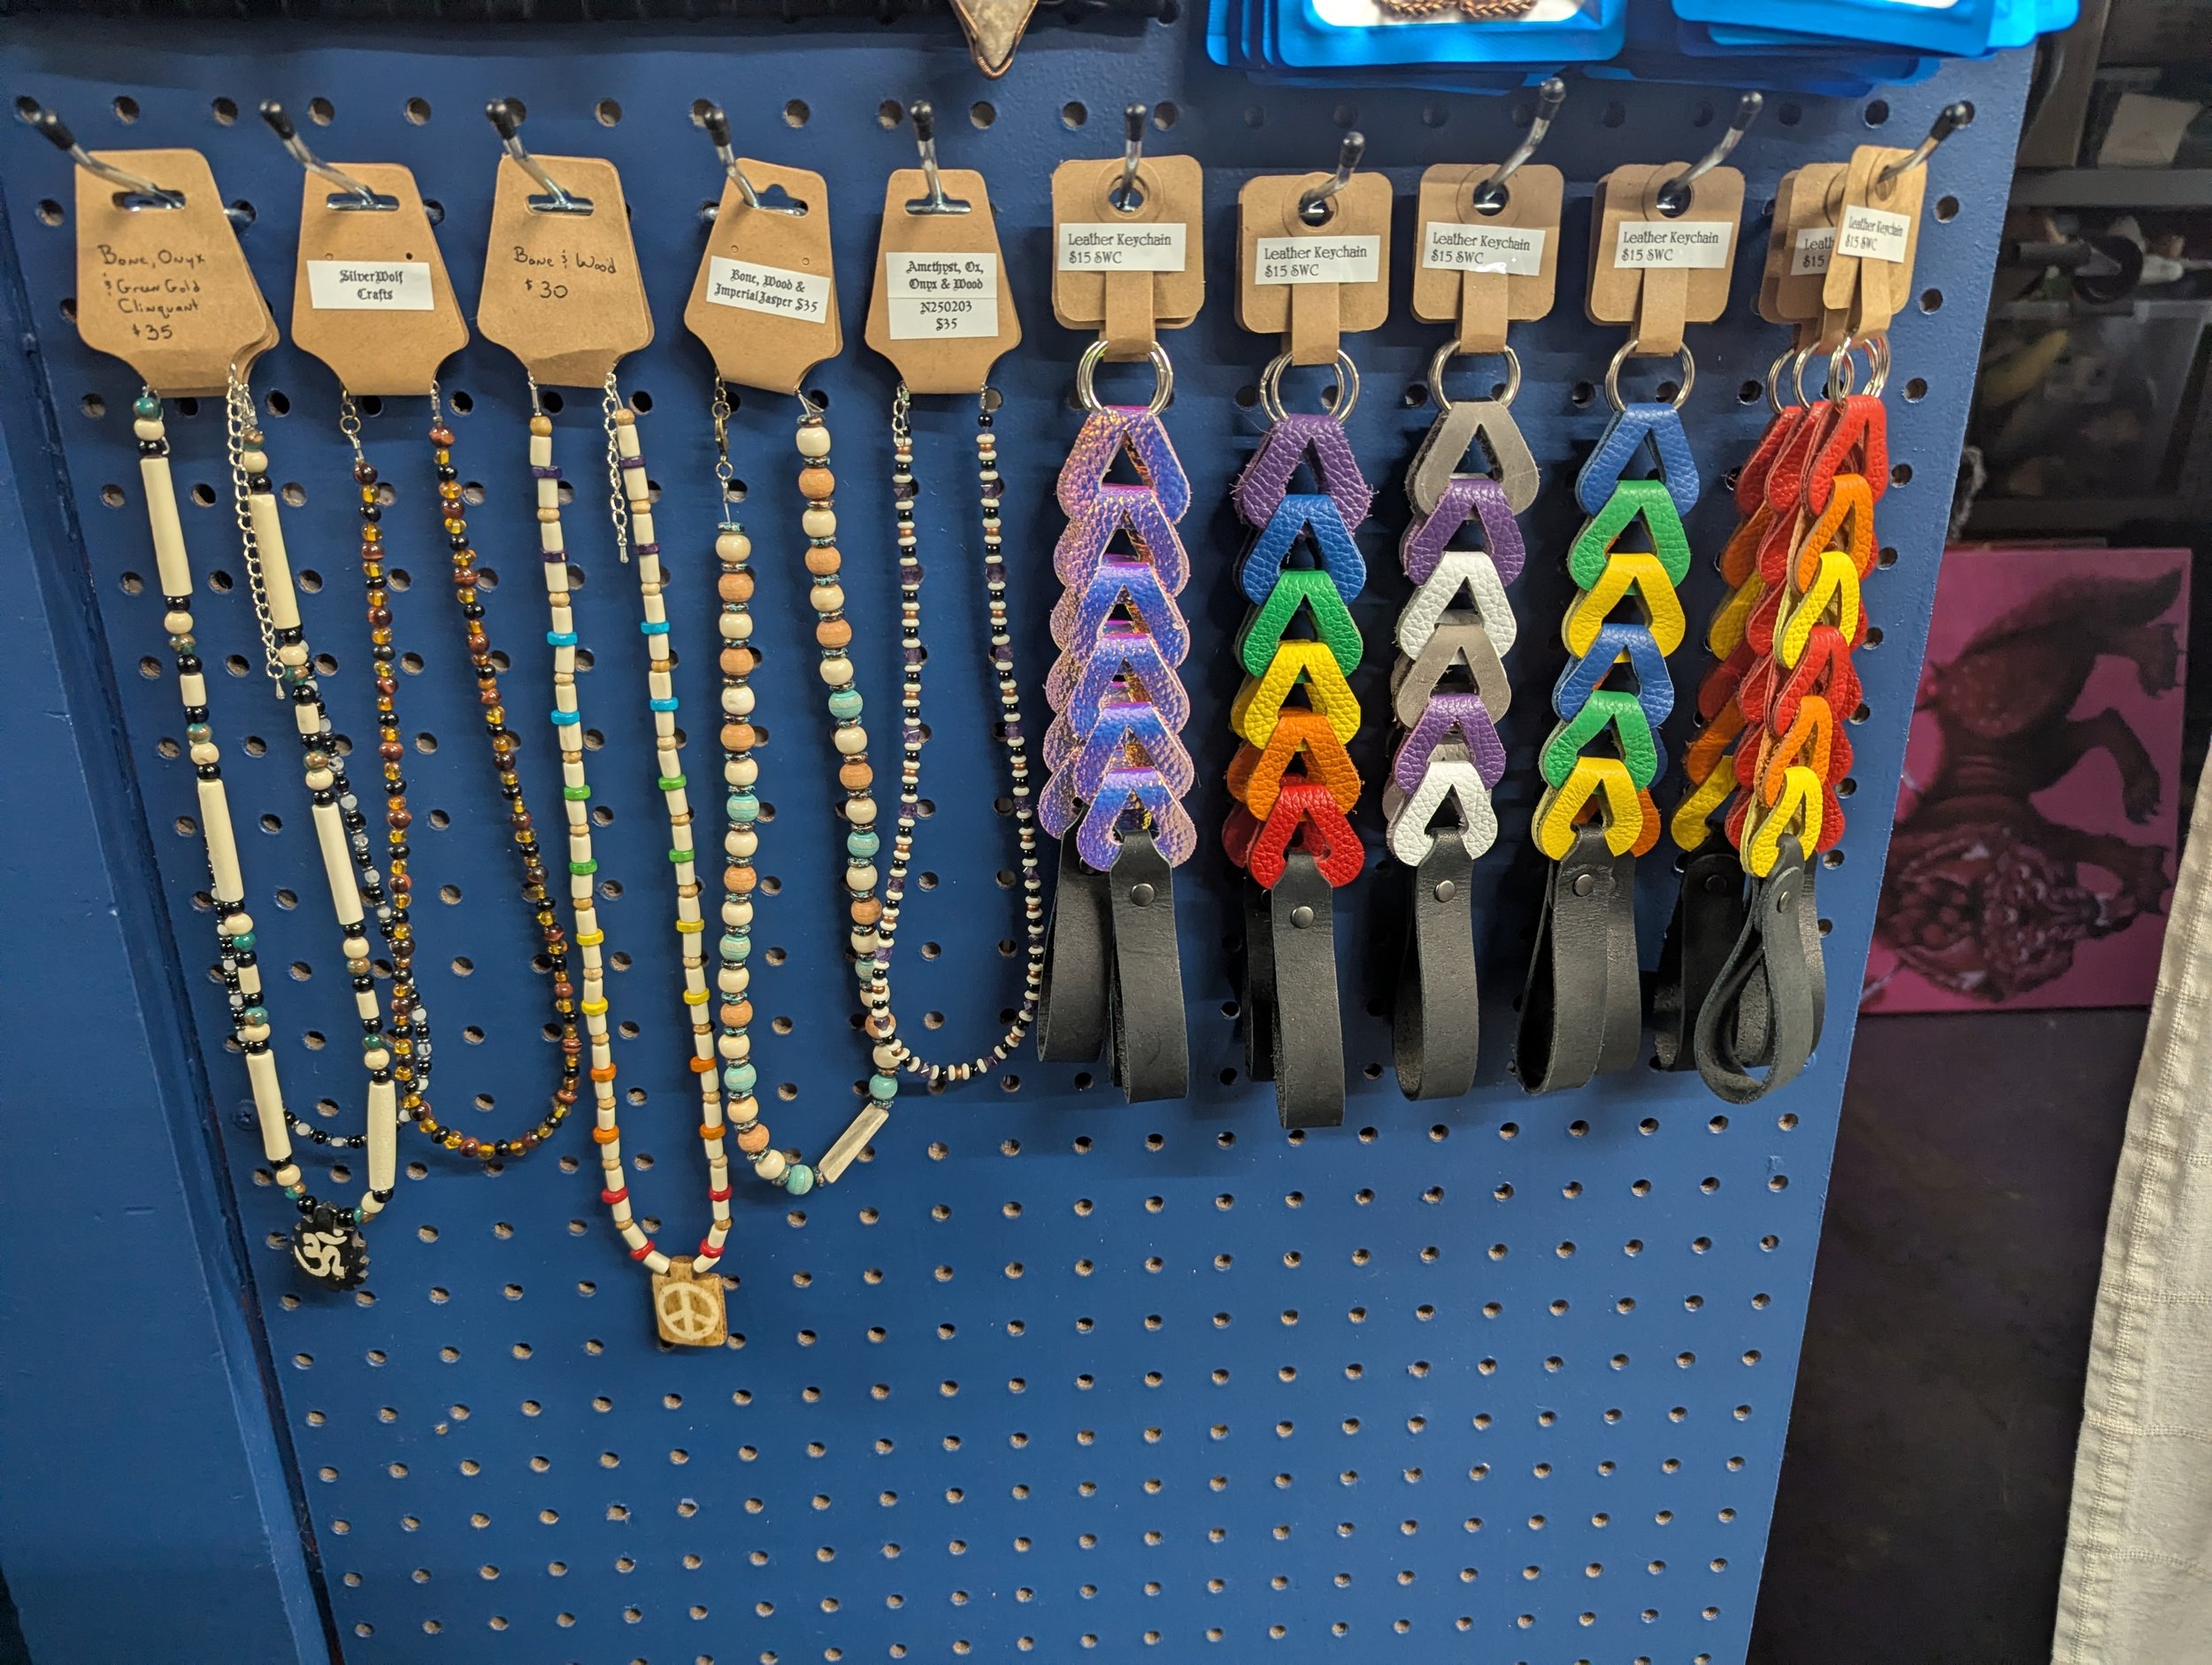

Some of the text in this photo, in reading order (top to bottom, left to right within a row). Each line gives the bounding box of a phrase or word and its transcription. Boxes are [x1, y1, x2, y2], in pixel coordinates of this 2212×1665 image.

[1848, 216, 1903, 237] Leather Keychain
[1068, 233, 1171, 248] Leather Keychain
[1432, 232, 1531, 251] Leather Keychain
[1623, 231, 1719, 245] Leather Keychain
[1845, 234, 1878, 251] $15 SWC
[97, 244, 205, 269] Bone, Onyx
[1069, 250, 1122, 264] $15 SWC
[1264, 244, 1367, 260] Leather Keychain
[1431, 249, 1484, 264] $15 SWC
[1621, 249, 1673, 261] $15 SWC
[513, 246, 554, 267] Bone
[576, 252, 617, 274] Wood
[906, 260, 984, 275] Amethyst, Ox,
[1802, 254, 1824, 268] $15
[339, 269, 403, 285] SilverWolf
[1264, 264, 1319, 278] $15 SWC
[165, 278, 201, 294] Gold
[730, 269, 805, 293] Bone, Wood &
[909, 278, 983, 292] Onyx & Wood
[357, 288, 393, 303] Crafts
[118, 298, 199, 318] Clinquant
[795, 297, 818, 313] $35
[920, 301, 972, 315] N250203
[935, 318, 957, 332] $35
